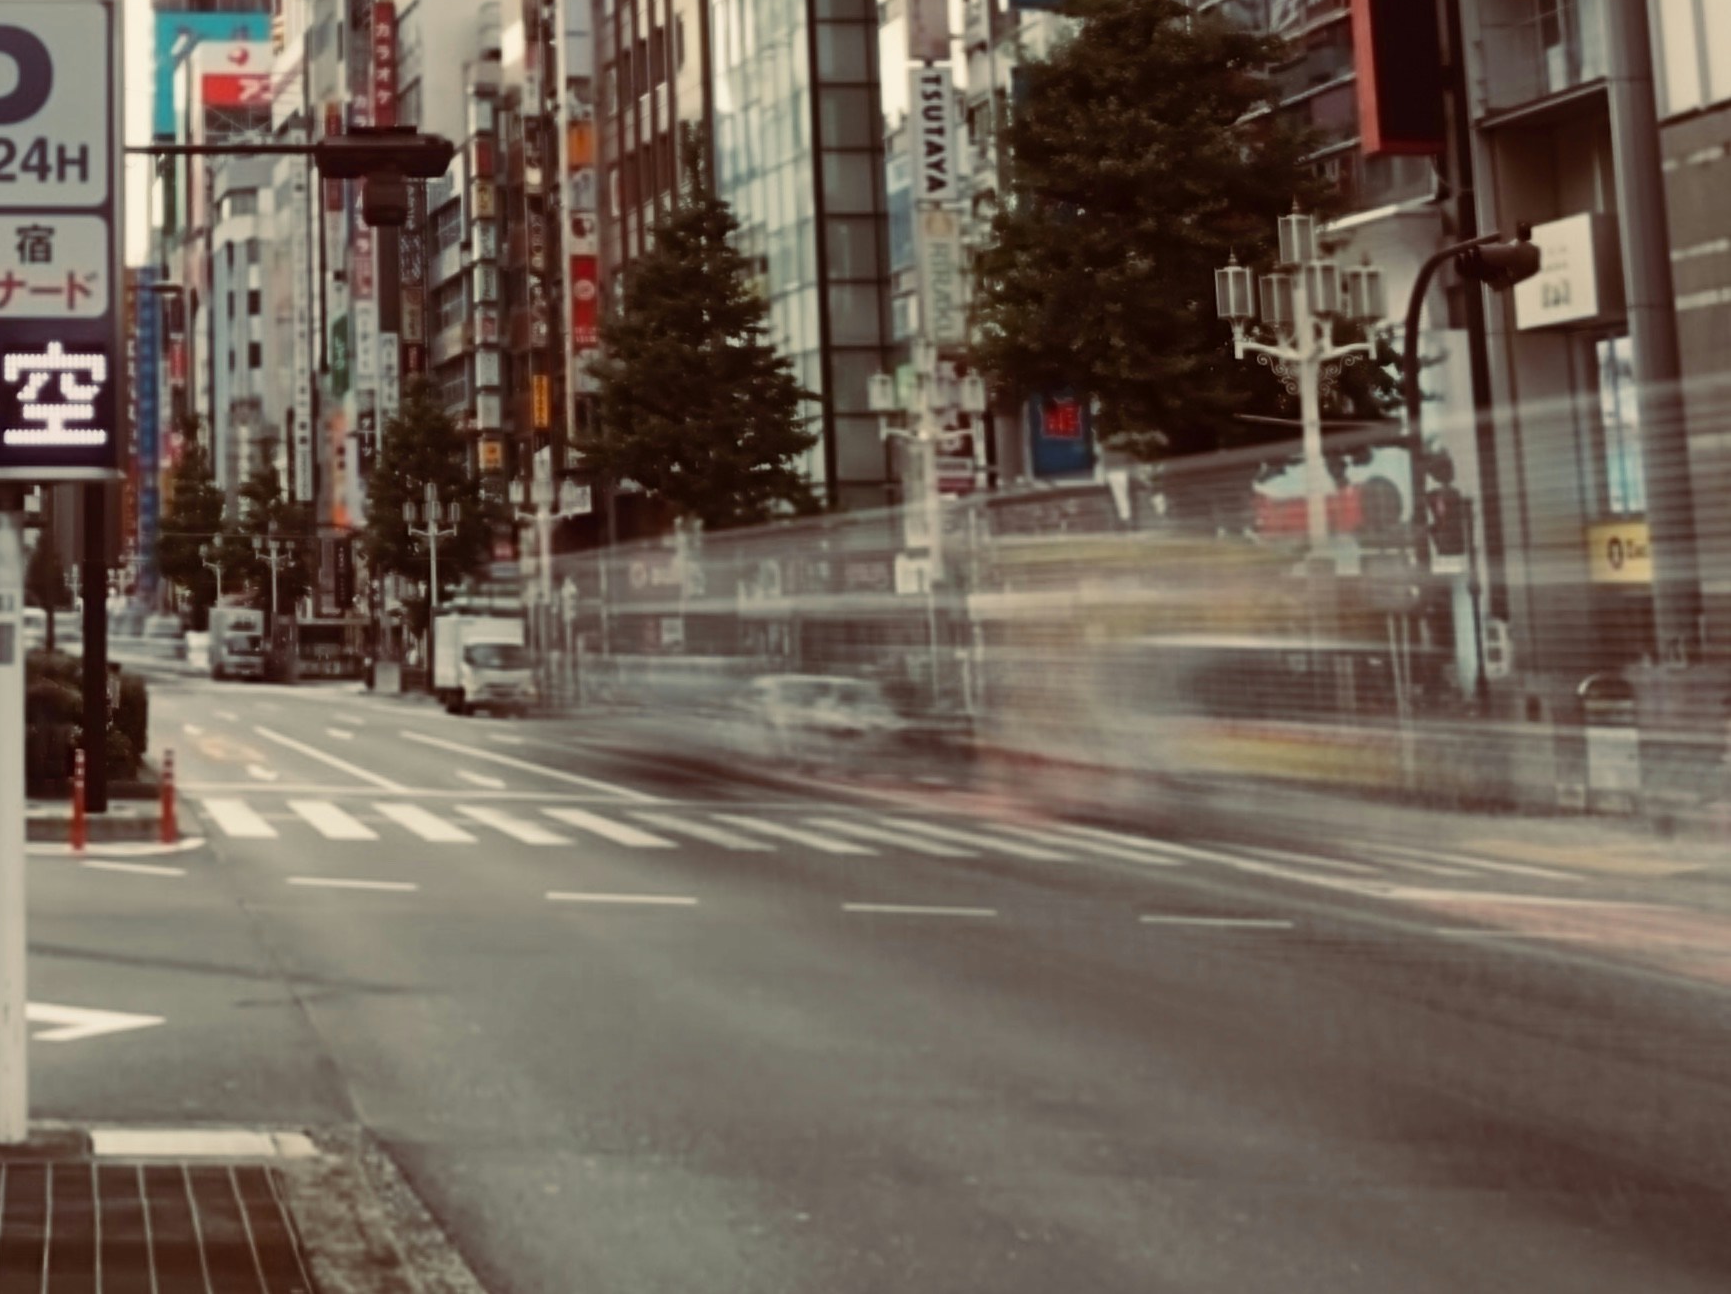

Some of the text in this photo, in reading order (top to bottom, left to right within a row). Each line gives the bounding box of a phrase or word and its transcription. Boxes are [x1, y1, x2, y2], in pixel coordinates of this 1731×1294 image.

[375, 23, 393, 105] カラオケ
[919, 73, 949, 195] TSUTAYA
[3, 340, 108, 446] 空
